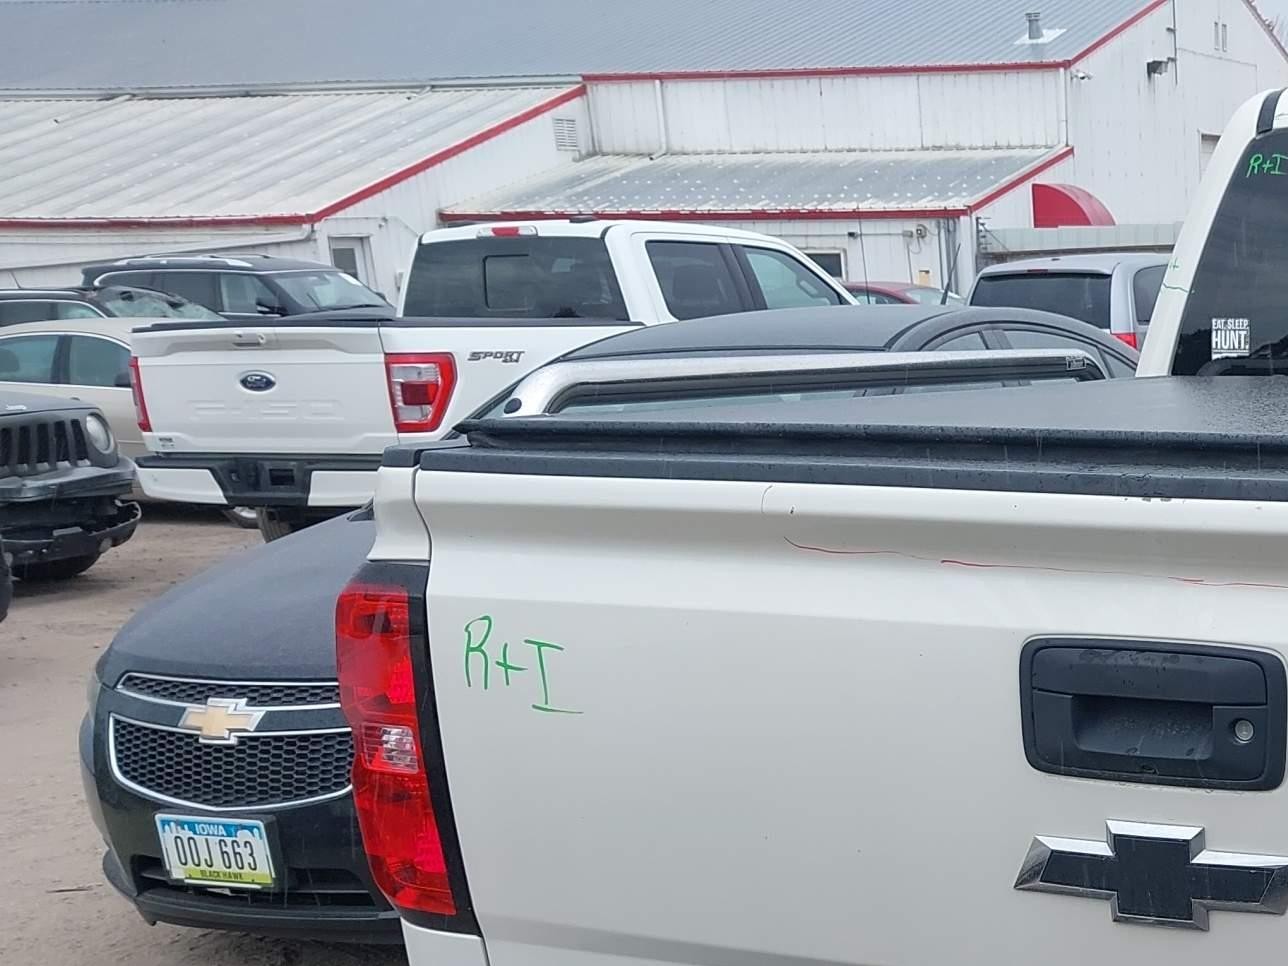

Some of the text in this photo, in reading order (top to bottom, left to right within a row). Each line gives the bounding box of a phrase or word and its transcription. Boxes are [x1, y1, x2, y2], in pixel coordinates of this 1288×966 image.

[1212, 330, 1249, 350] HUNT.
[467, 351, 525, 362] SPORT
[464, 614, 584, 714] R+I
[194, 823, 227, 837] IOWA
[219, 839, 257, 871] 663
